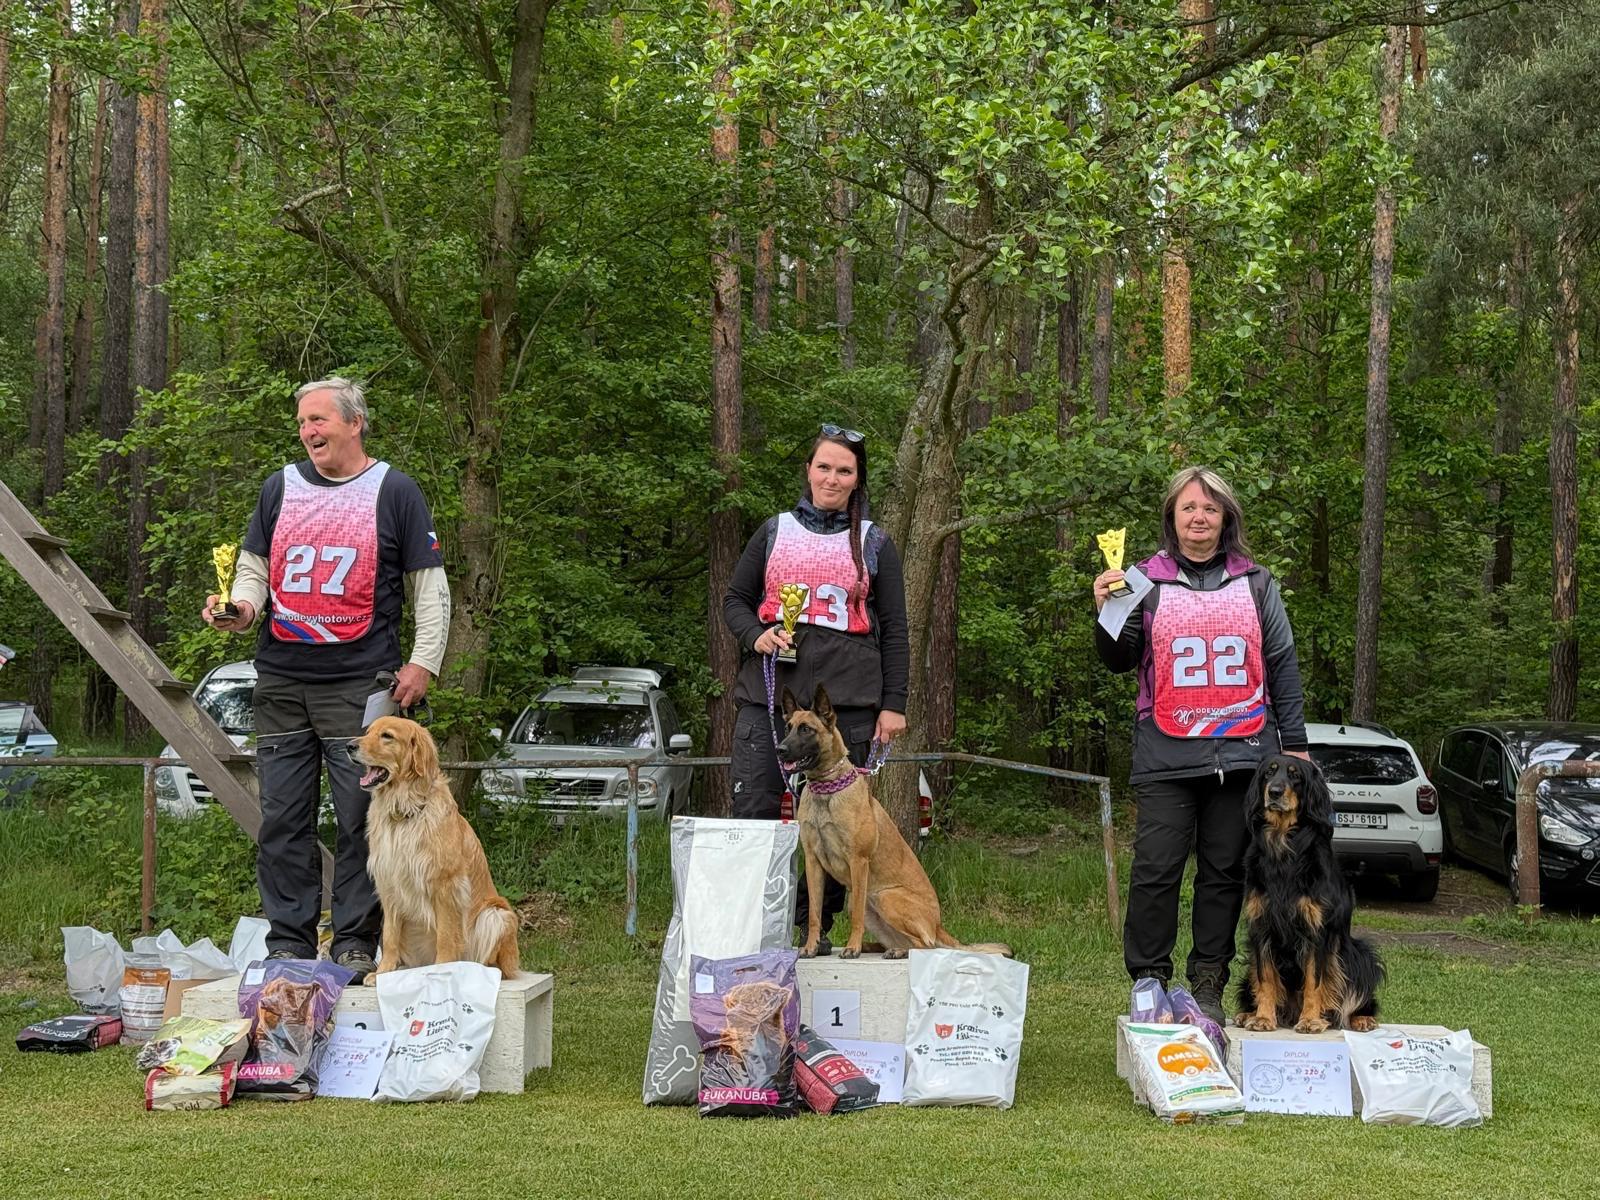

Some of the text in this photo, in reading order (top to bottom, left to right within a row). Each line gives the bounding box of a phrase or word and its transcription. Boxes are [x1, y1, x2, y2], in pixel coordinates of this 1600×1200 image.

[281, 545, 358, 596] 27
[1171, 636, 1248, 687] 22
[1337, 790, 1382, 798] DACIA
[1337, 813, 1383, 825] 6SJ 6181
[728, 833, 740, 841] EU
[831, 1006, 843, 1027] 1
[843, 1049, 868, 1057] DIPLOM
[238, 1066, 281, 1076] KANUBA
[703, 1090, 768, 1102] EUKANUBA
